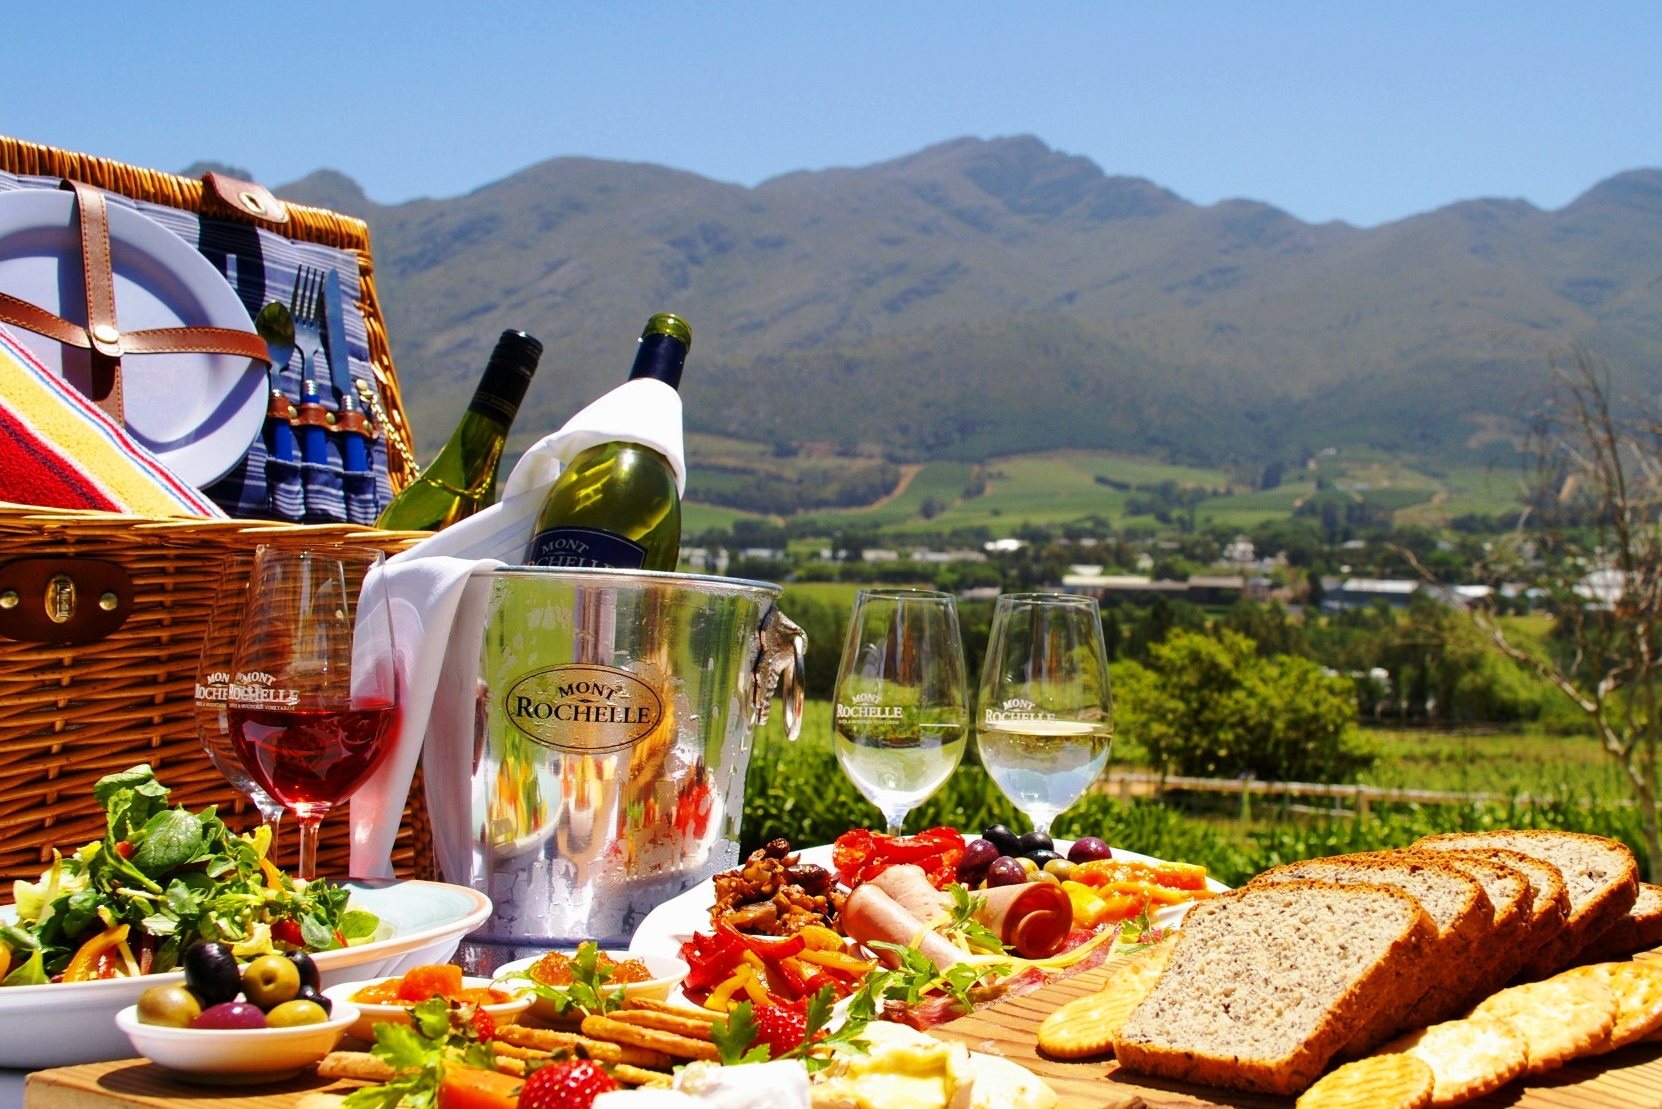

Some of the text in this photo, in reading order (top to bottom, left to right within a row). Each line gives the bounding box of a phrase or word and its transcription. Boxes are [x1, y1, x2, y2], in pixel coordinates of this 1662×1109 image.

[542, 539, 589, 554] MONT
[207, 672, 230, 685] MON
[241, 671, 277, 686] MONT
[195, 683, 228, 700] ROCHE
[558, 681, 618, 700] MONT
[852, 693, 881, 704] MONT
[1002, 698, 1035, 711] MONT
[516, 696, 650, 724] ROCHELLE
[836, 703, 903, 718] ROCHELLE
[985, 709, 1056, 723] ROCHELLE
